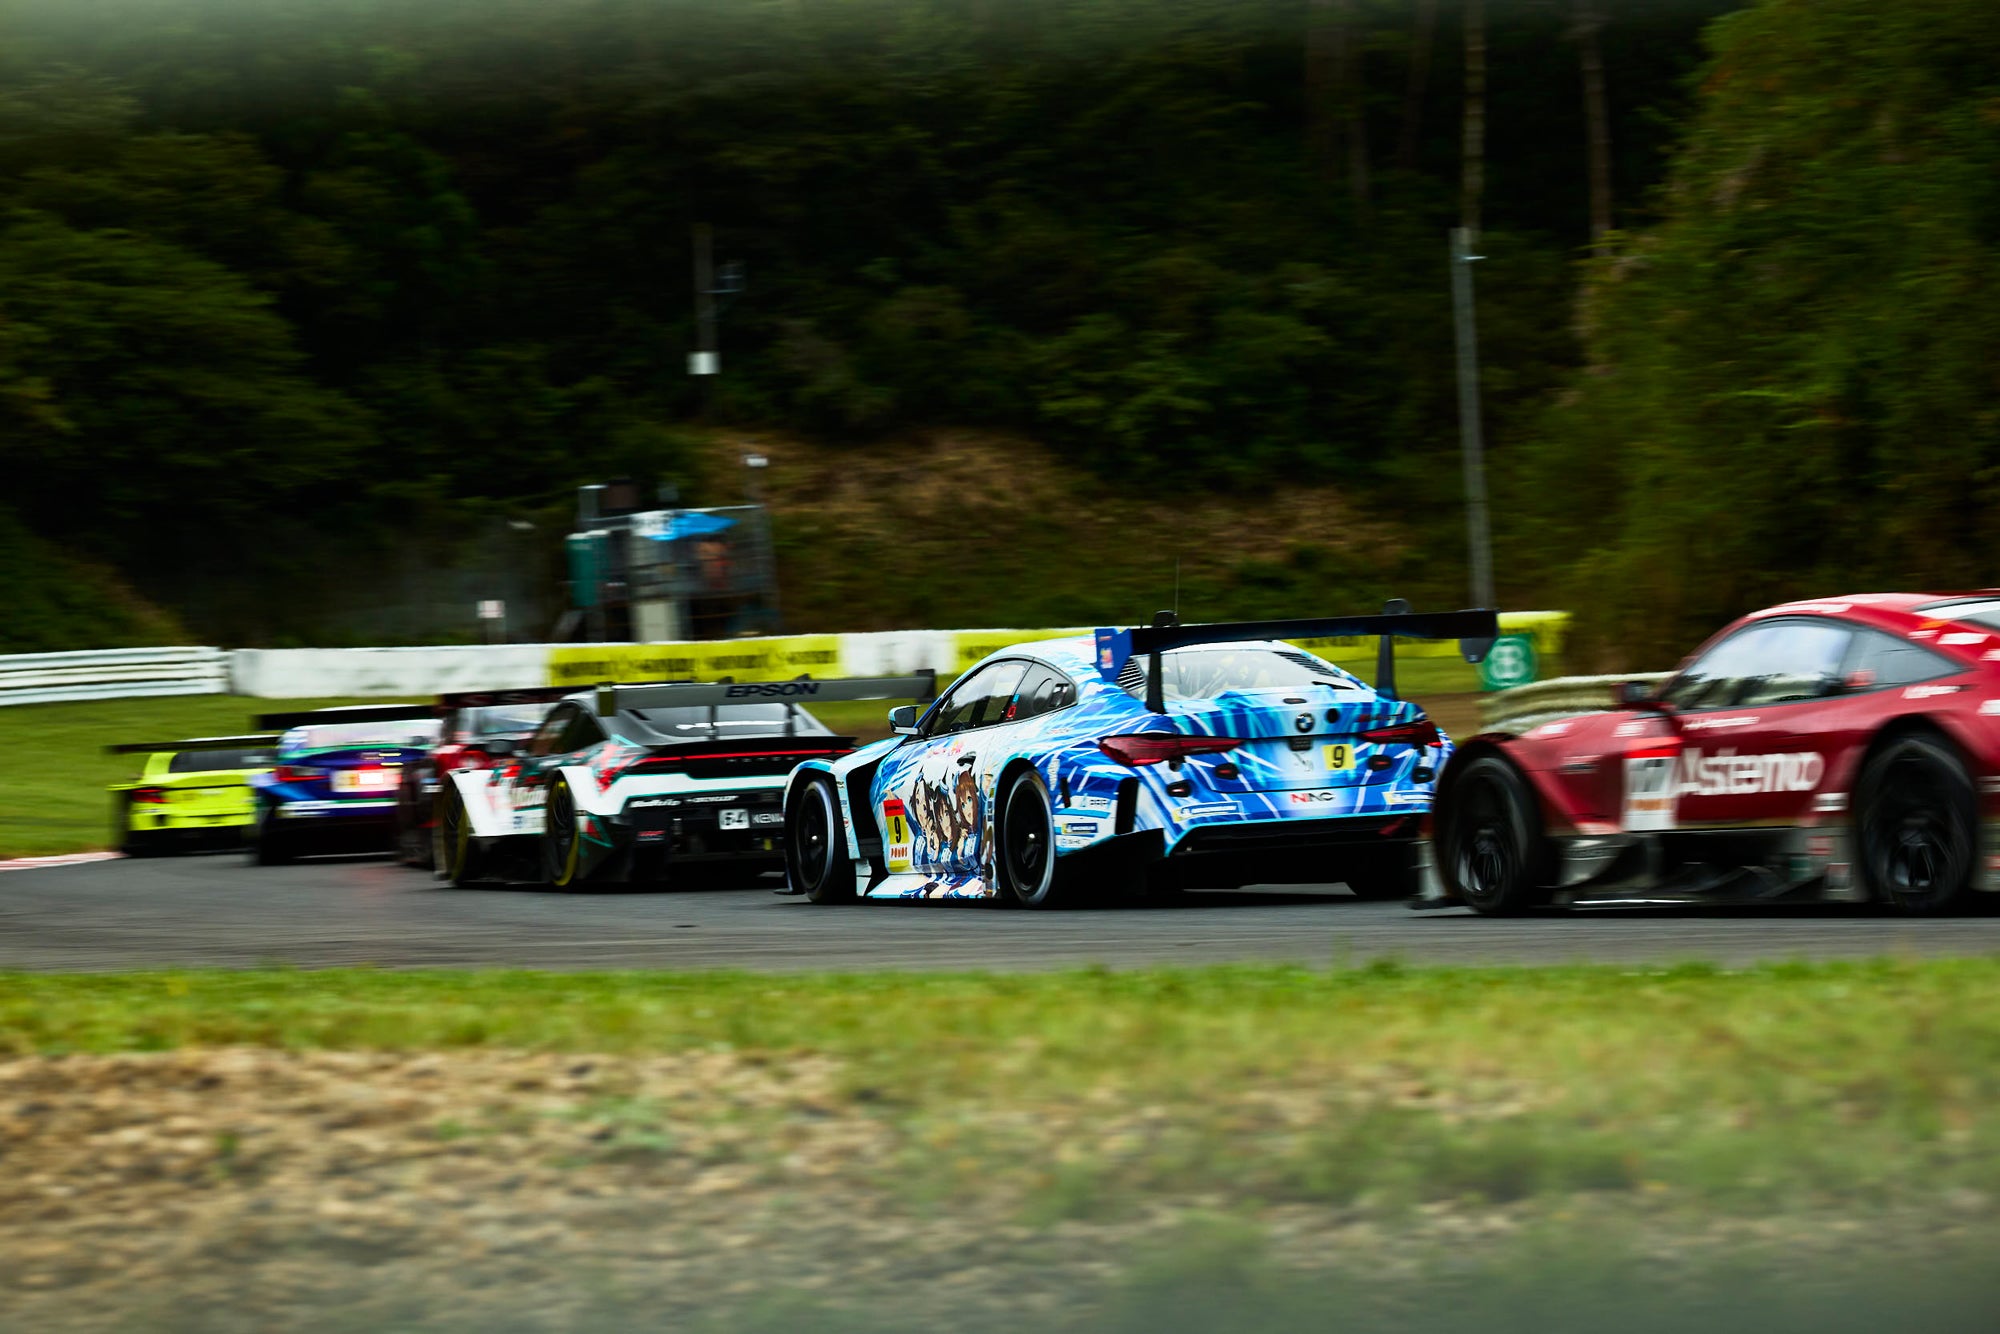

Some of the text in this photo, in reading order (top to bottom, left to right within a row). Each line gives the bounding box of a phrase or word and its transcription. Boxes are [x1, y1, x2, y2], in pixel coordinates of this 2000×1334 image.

[725, 683, 819, 697] EPSON
[1333, 746, 1345, 768] 9
[1670, 748, 1825, 795] Astemo
[894, 816, 902, 843] 9
